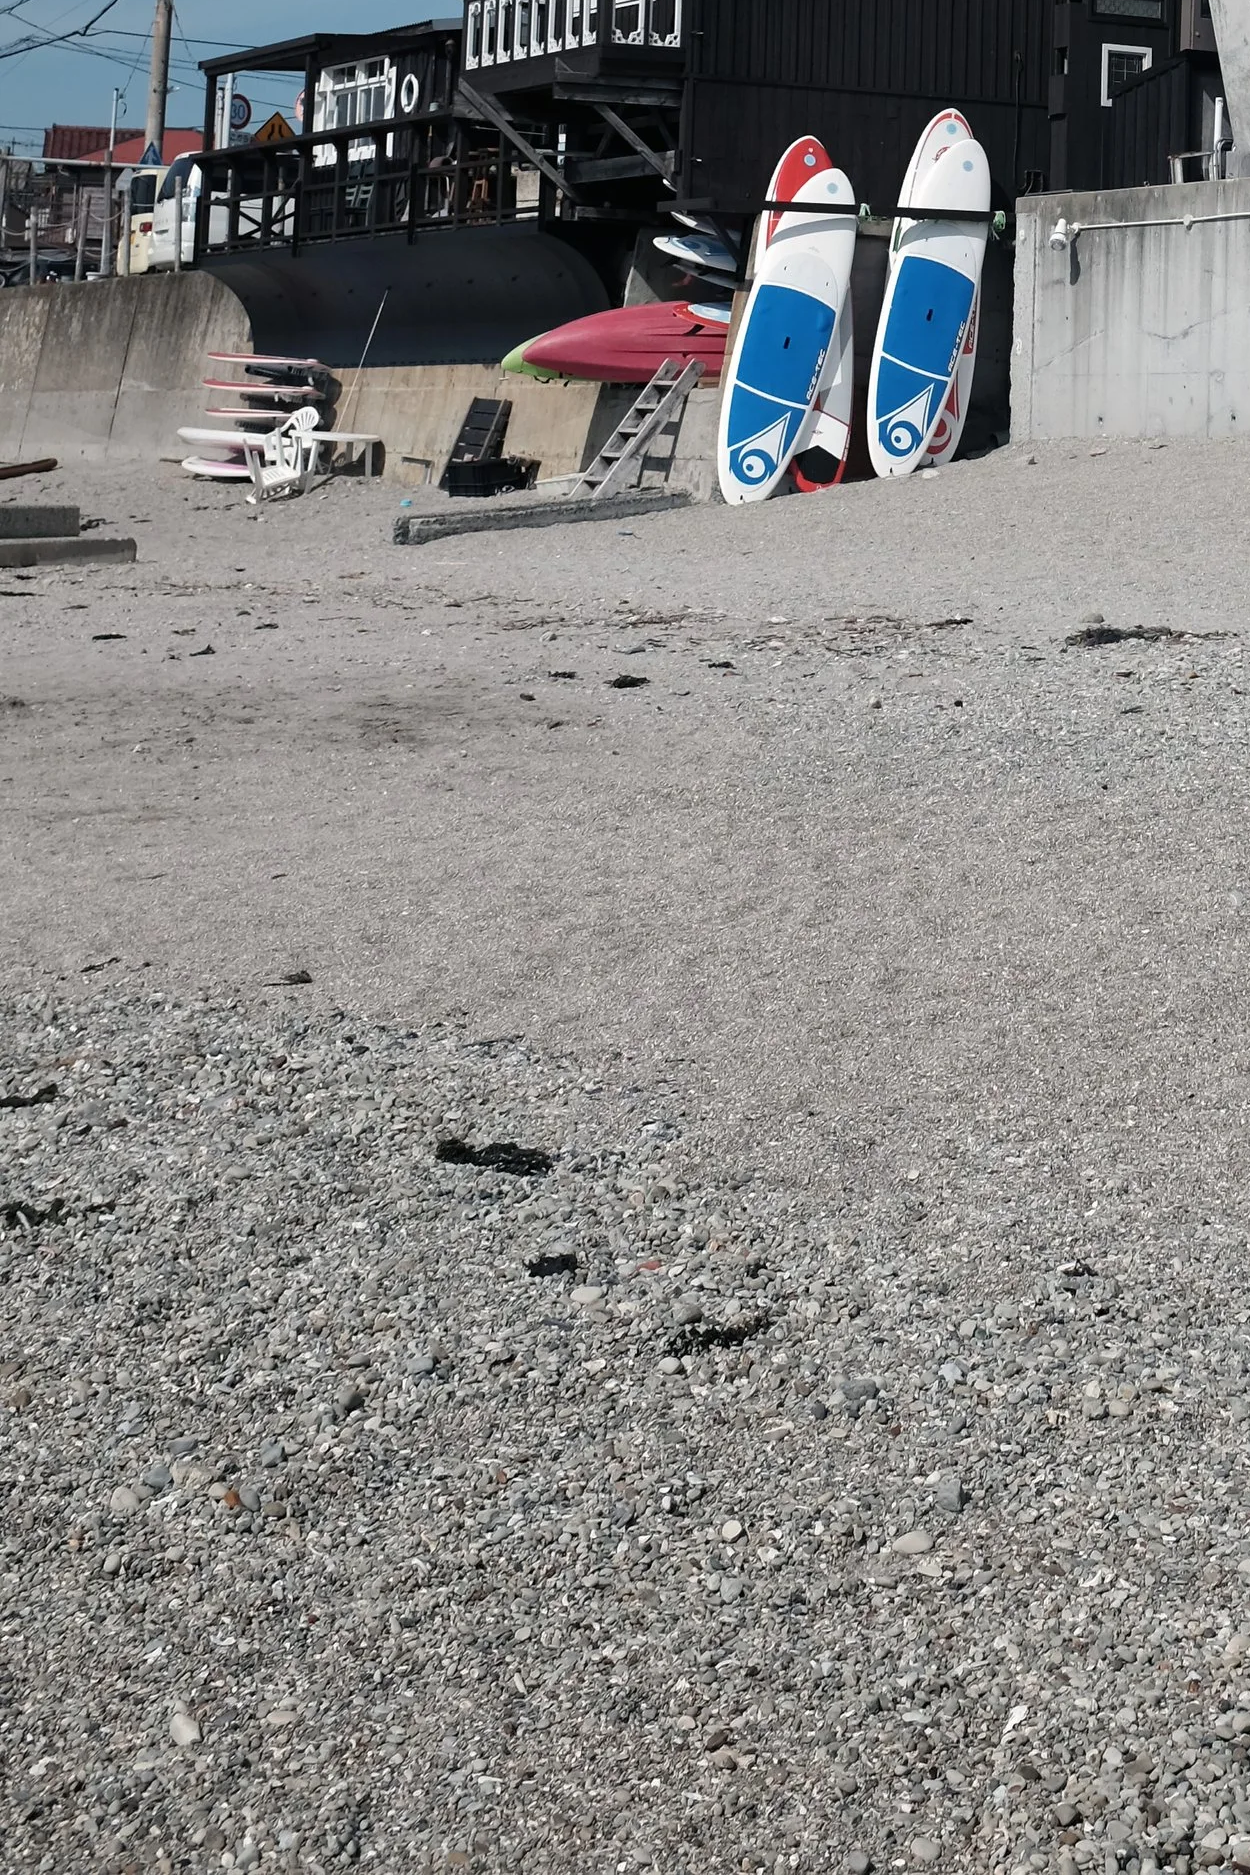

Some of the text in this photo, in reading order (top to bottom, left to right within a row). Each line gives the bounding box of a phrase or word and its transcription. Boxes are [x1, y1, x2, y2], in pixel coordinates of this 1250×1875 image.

[231, 104, 245, 119] 30
[947, 320, 966, 373] ACE-TEC
[806, 348, 826, 401] ACE-TEC
